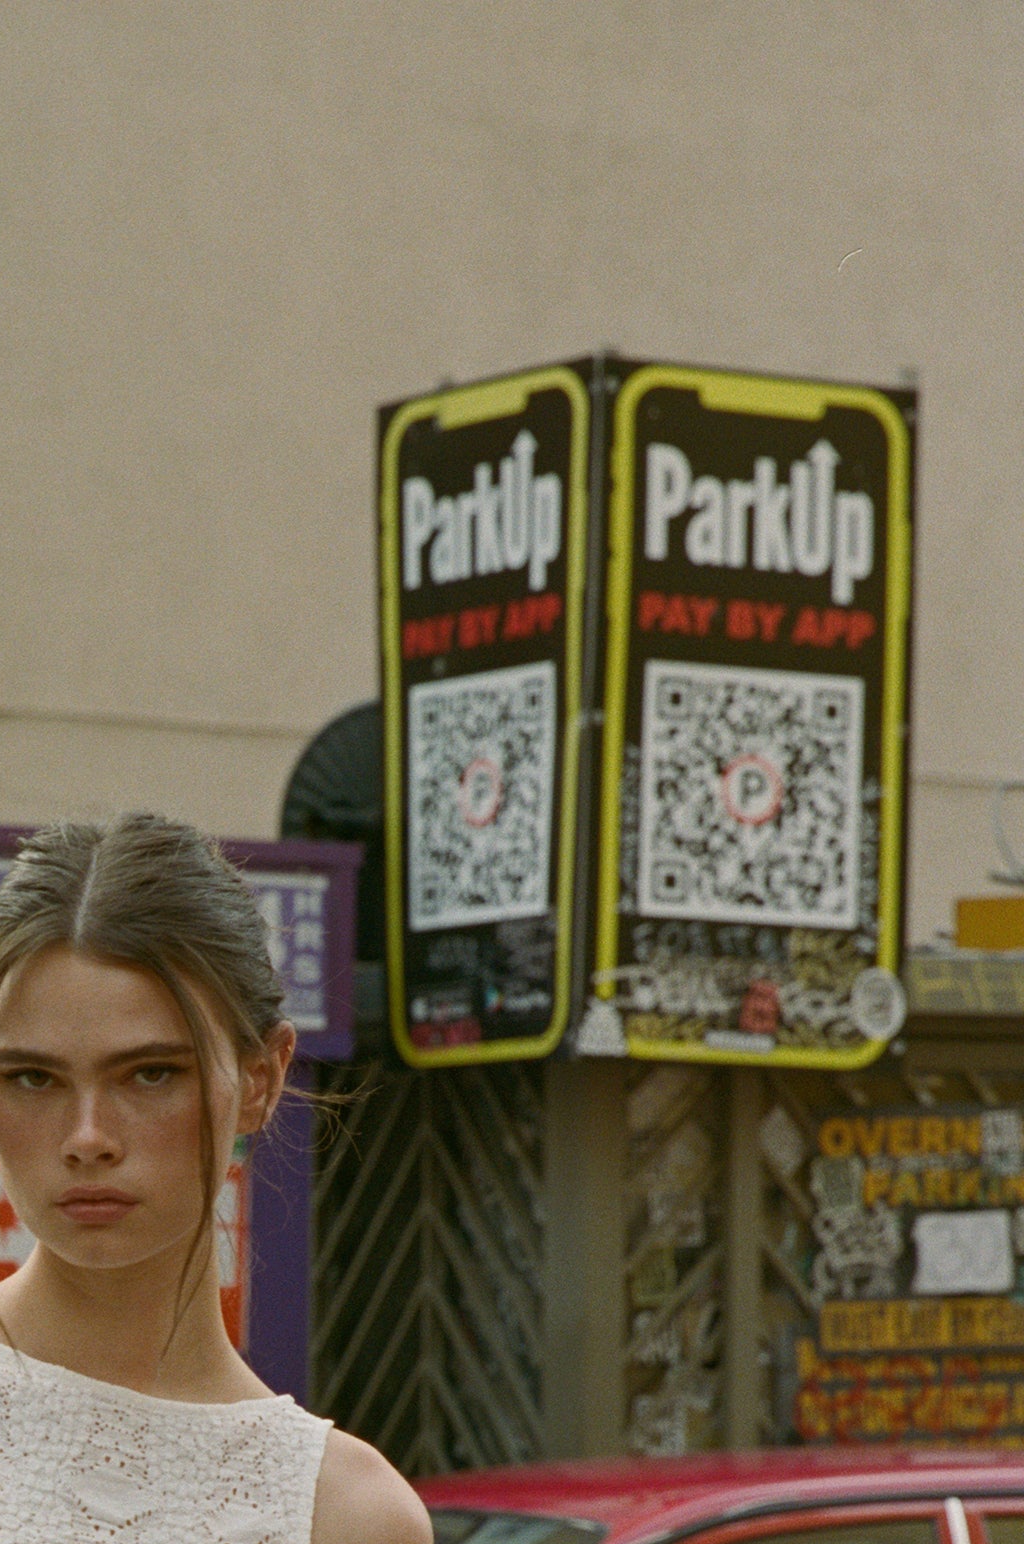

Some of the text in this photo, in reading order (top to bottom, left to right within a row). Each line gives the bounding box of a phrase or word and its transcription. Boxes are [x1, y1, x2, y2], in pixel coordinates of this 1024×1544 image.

[402, 430, 563, 591] ParkUp
[644, 438, 875, 606] ParkUp
[458, 604, 501, 649] BY
[502, 593, 563, 642] APP
[638, 592, 875, 650] PAY BY APP
[818, 1114, 981, 1158] OVERN
